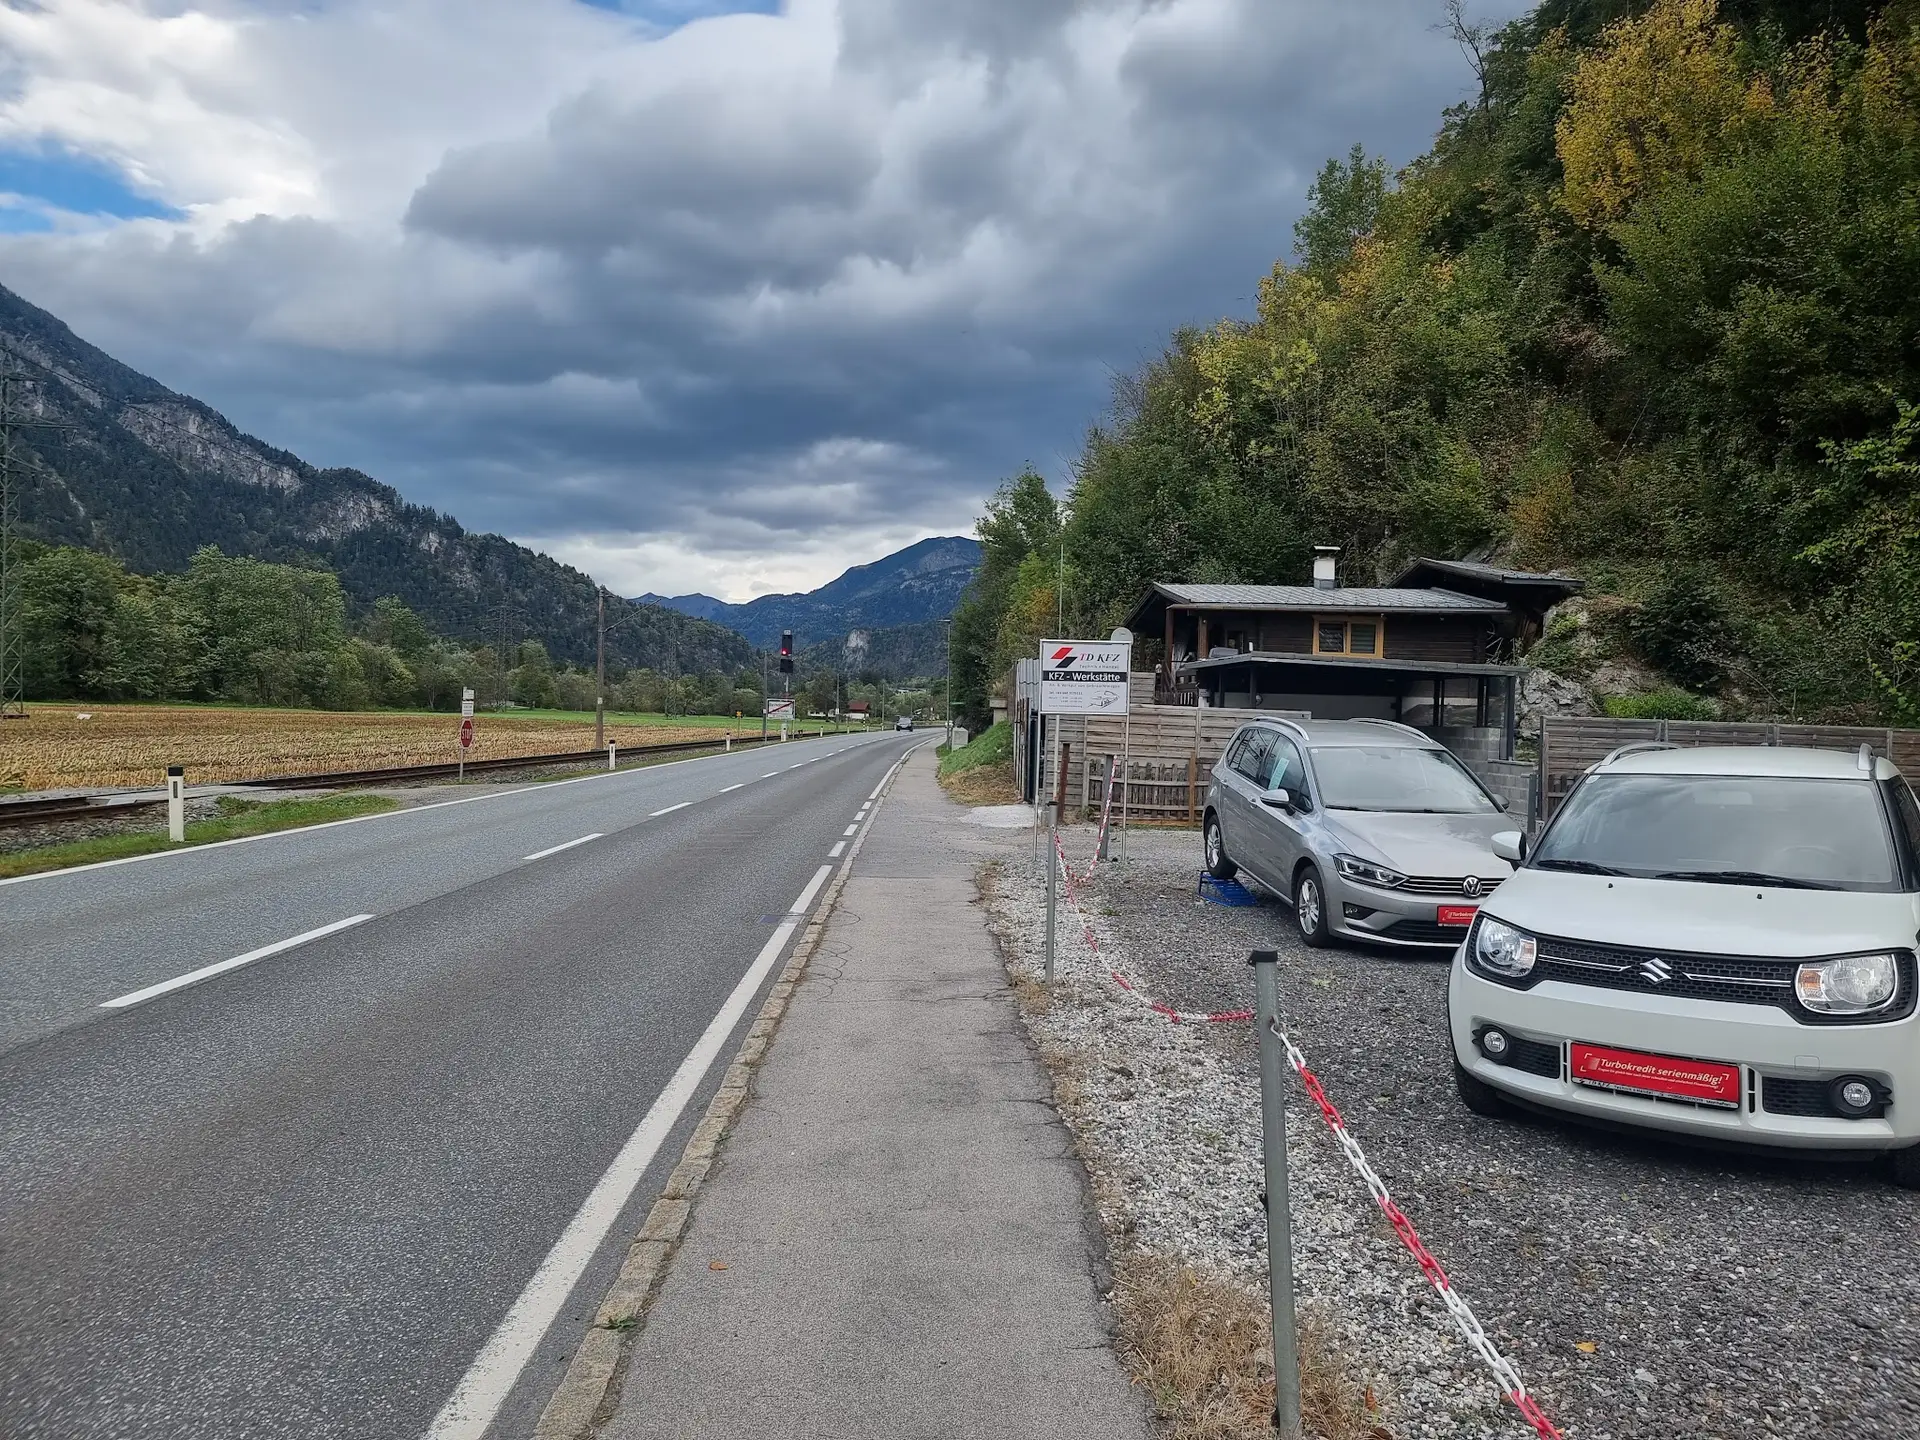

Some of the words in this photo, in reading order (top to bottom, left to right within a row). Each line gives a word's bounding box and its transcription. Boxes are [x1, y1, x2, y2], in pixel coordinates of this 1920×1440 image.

[1080, 653, 1094, 662] TD
[1097, 653, 1120, 663] KFZ
[1048, 672, 1064, 680] KFZ
[1072, 672, 1120, 682] Werkstätte
[462, 728, 472, 739] STOP
[1601, 1059, 1656, 1074] Turbokredit
[1658, 1069, 1722, 1085] serienmäßig!
